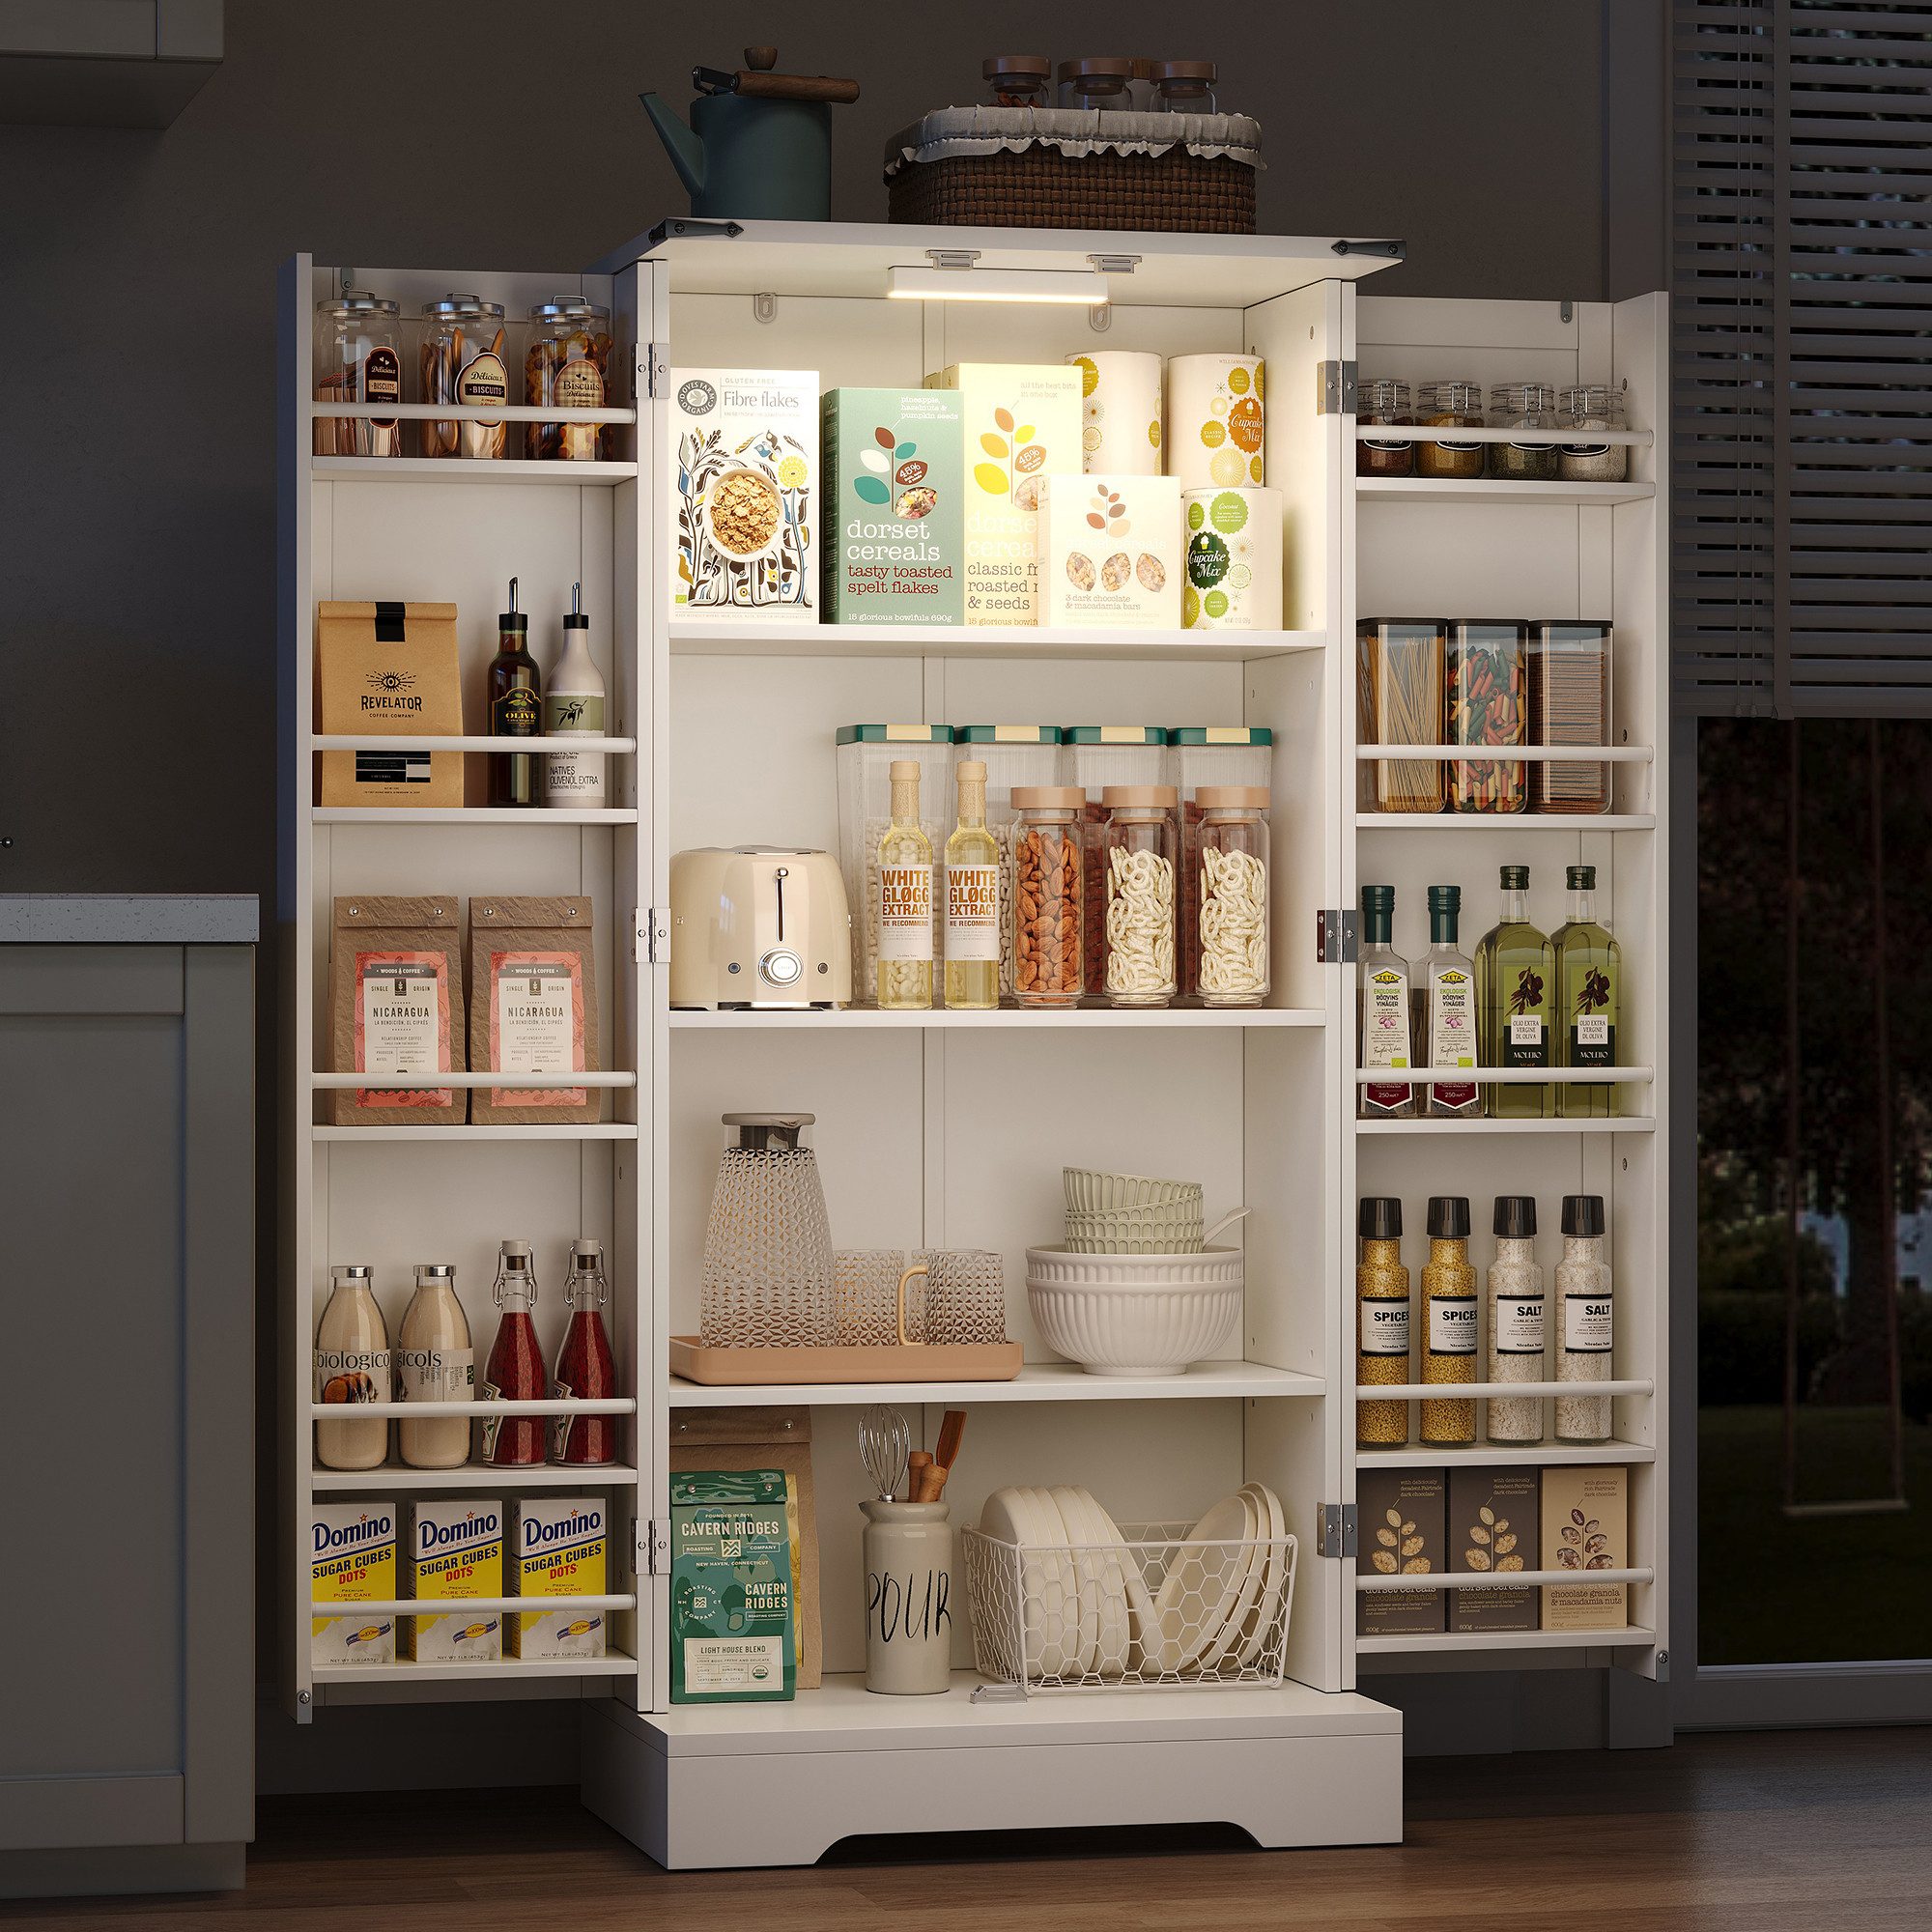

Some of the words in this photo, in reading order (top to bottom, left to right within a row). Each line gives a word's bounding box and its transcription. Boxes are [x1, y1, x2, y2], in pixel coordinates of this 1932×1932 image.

[473, 386, 502, 395] BISCUITS
[563, 381, 600, 391] Biscuits
[724, 390, 757, 407] Fibre
[762, 391, 799, 408] flakes
[682, 401, 714, 415] ORGANIC
[847, 520, 930, 539] dorset
[847, 543, 941, 561] cereals
[1189, 551, 1226, 567] Cupcake
[848, 565, 890, 580] tasty
[894, 566, 953, 579] toasted
[968, 562, 1022, 576] classic
[1197, 563, 1221, 579] Mix
[848, 582, 888, 595] spelt
[892, 582, 939, 594] flakes
[968, 581, 1029, 593] roasted
[968, 596, 981, 609] &
[986, 597, 1030, 610] seeds
[361, 696, 422, 712] REVELATOR
[551, 766, 576, 776] NATIVES
[579, 776, 599, 784] EXTRA
[882, 870, 929, 886] WHITE
[949, 870, 996, 886] WHITE
[883, 887, 929, 903] GLØGG
[950, 887, 996, 903] GLØGG
[883, 904, 929, 916] EXTRACT
[950, 904, 996, 916] EXTRACT
[374, 1008, 430, 1017] NICARAGUA
[508, 1008, 564, 1017] NICARAGUA
[1518, 1306, 1542, 1317] SALT
[1585, 1305, 1610, 1316] SALT
[312, 1517, 391, 1551] Domino
[419, 1515, 497, 1549] Domino
[523, 1512, 601, 1547] Domino
[682, 1522, 730, 1536] CAVERN
[735, 1521, 780, 1535] RIDGES
[313, 1560, 352, 1578] SUGAR
[355, 1548, 391, 1568] CUBES
[420, 1557, 458, 1577] SUGAR
[463, 1546, 498, 1566] CUBES
[525, 1555, 562, 1574] SUGAR
[566, 1544, 602, 1563] CUBES
[339, 1569, 367, 1584] DOTS
[446, 1566, 473, 1582] DOTS
[551, 1563, 577, 1579] DOTS
[684, 1584, 717, 1596] ROASTING
[746, 1583, 787, 1596] CAVERN
[1590, 1589, 1620, 1598] granola
[746, 1597, 788, 1609] RIDGES
[868, 1570, 952, 1642] POUR
[685, 1611, 716, 1621] COMPANY
